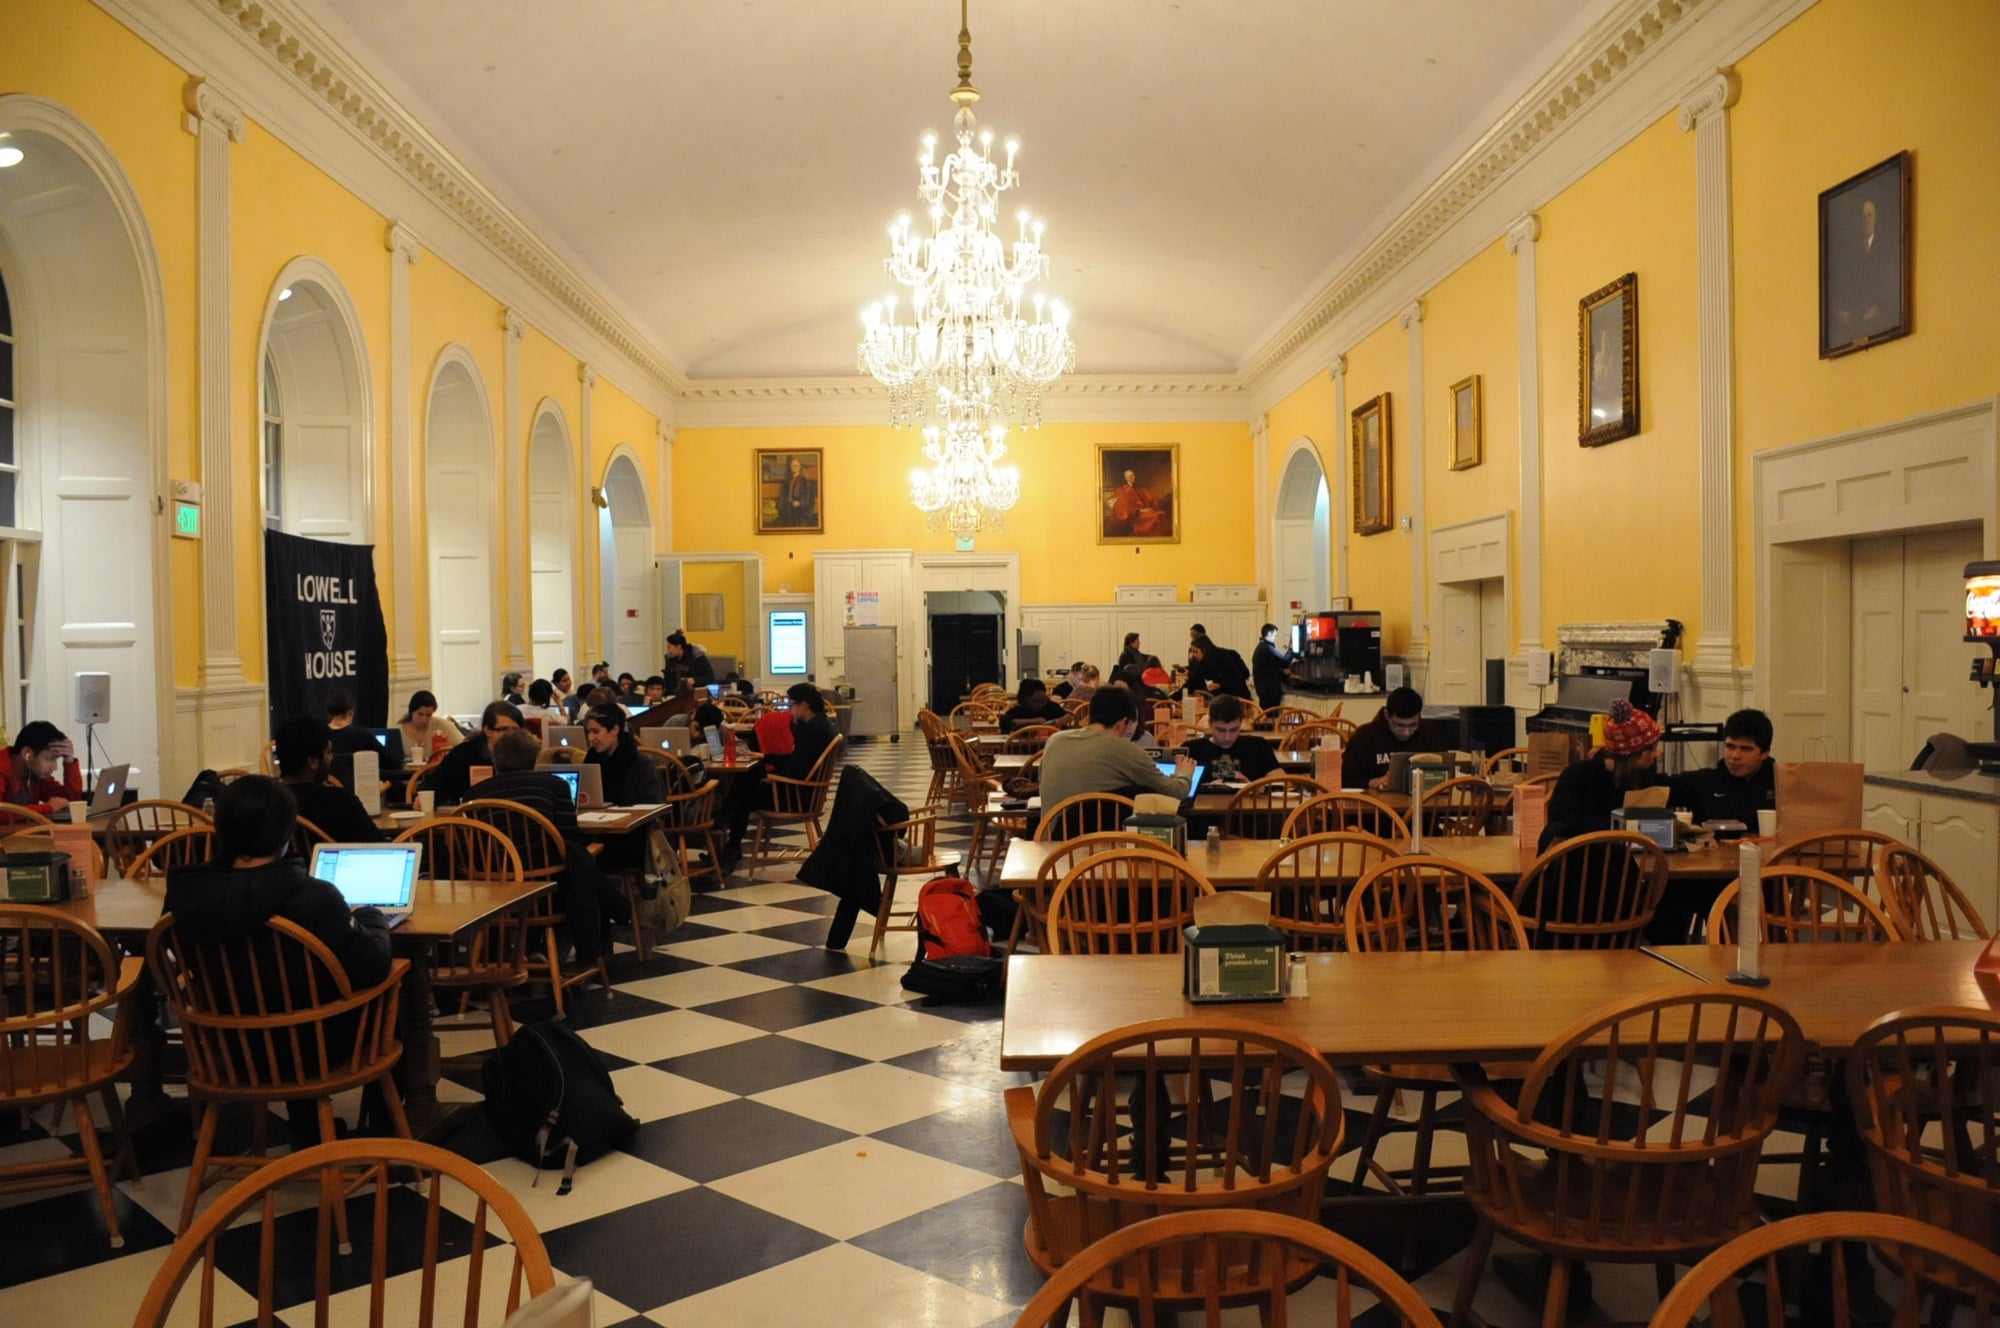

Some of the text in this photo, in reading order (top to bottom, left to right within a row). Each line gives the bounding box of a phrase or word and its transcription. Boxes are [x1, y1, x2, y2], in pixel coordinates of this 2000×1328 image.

[180, 506, 198, 533] EXIT
[297, 573, 357, 604] LOWELL
[305, 650, 356, 679] HOUSE
